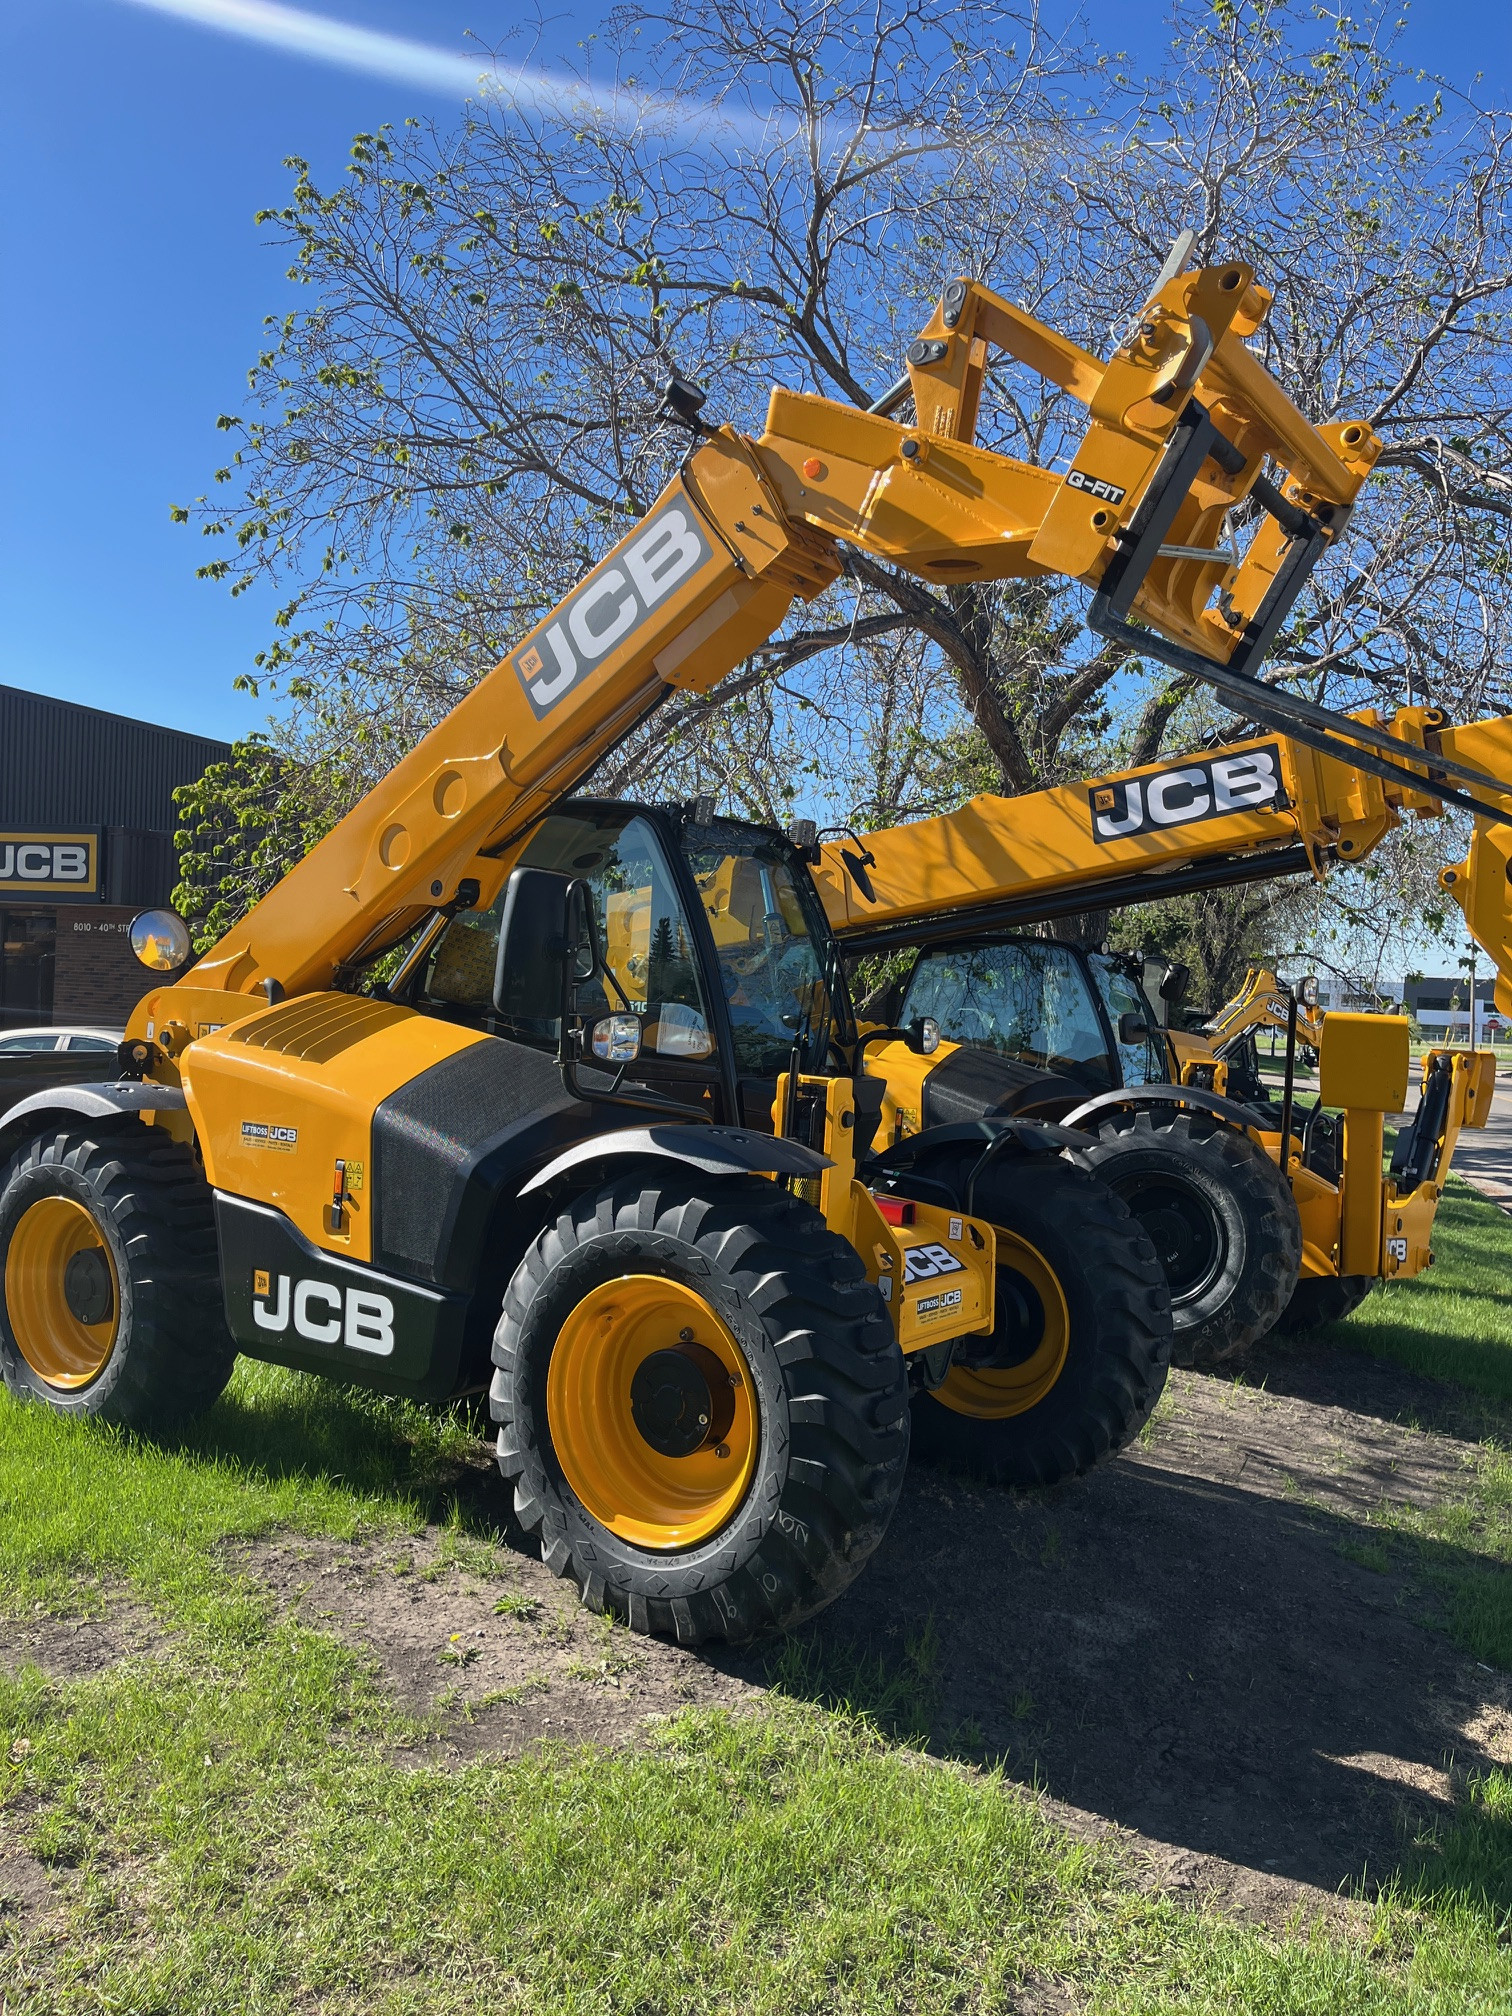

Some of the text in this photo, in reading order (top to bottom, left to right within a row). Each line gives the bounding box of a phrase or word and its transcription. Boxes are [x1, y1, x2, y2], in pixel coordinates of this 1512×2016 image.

[1067, 470, 1125, 503] Q-FIT
[530, 509, 701, 706] JCB
[1097, 753, 1278, 836] JCB
[73, 922, 91, 932] 8010
[1267, 1001, 1289, 1022] JCB
[242, 1125, 296, 1141] LIFTBOSS JCB
[905, 1246, 961, 1282] CB
[253, 1275, 395, 1356] JCB
[918, 1291, 961, 1311] LIFTBOSS JCB
